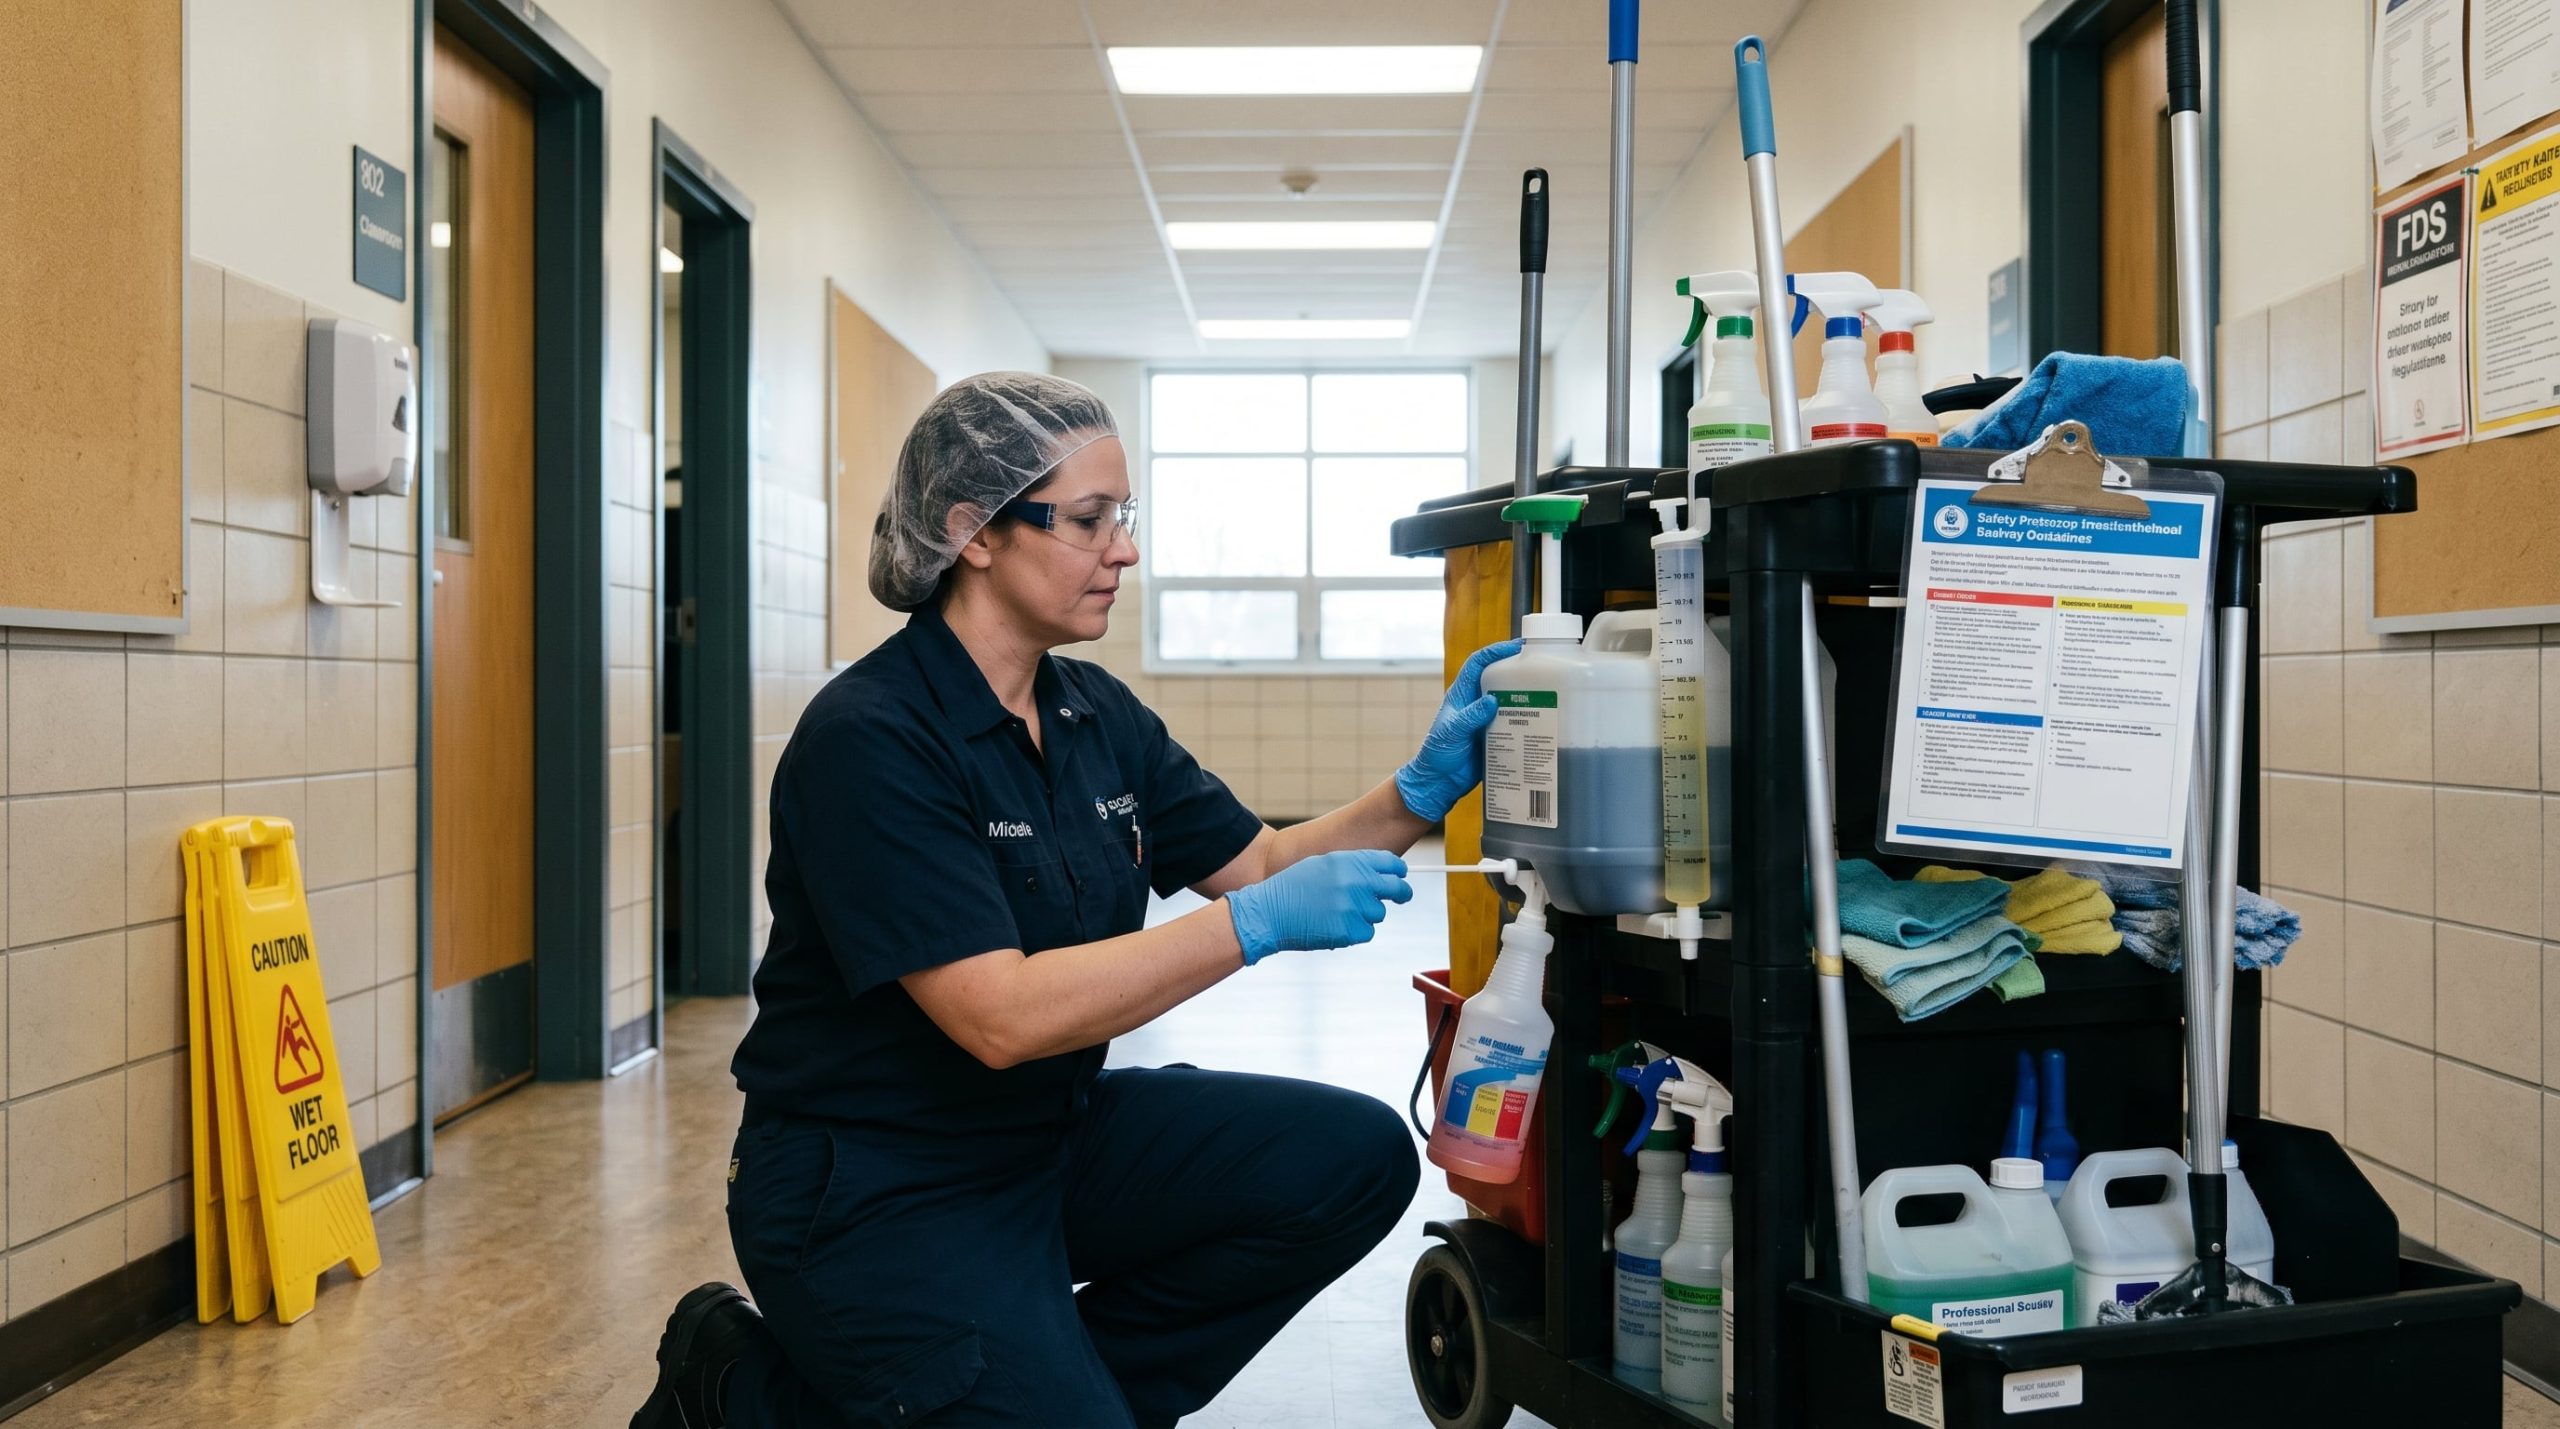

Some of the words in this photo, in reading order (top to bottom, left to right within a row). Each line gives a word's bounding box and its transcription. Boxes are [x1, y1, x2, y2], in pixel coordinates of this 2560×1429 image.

[360, 158, 385, 198] 802
[2396, 200, 2447, 258] FDS
[1977, 512, 2018, 528] Safety
[251, 933, 310, 973] CAUTION
[289, 1094, 325, 1131] WET
[287, 1123, 341, 1170] FLOOR
[1942, 1302, 2015, 1319] Professional
